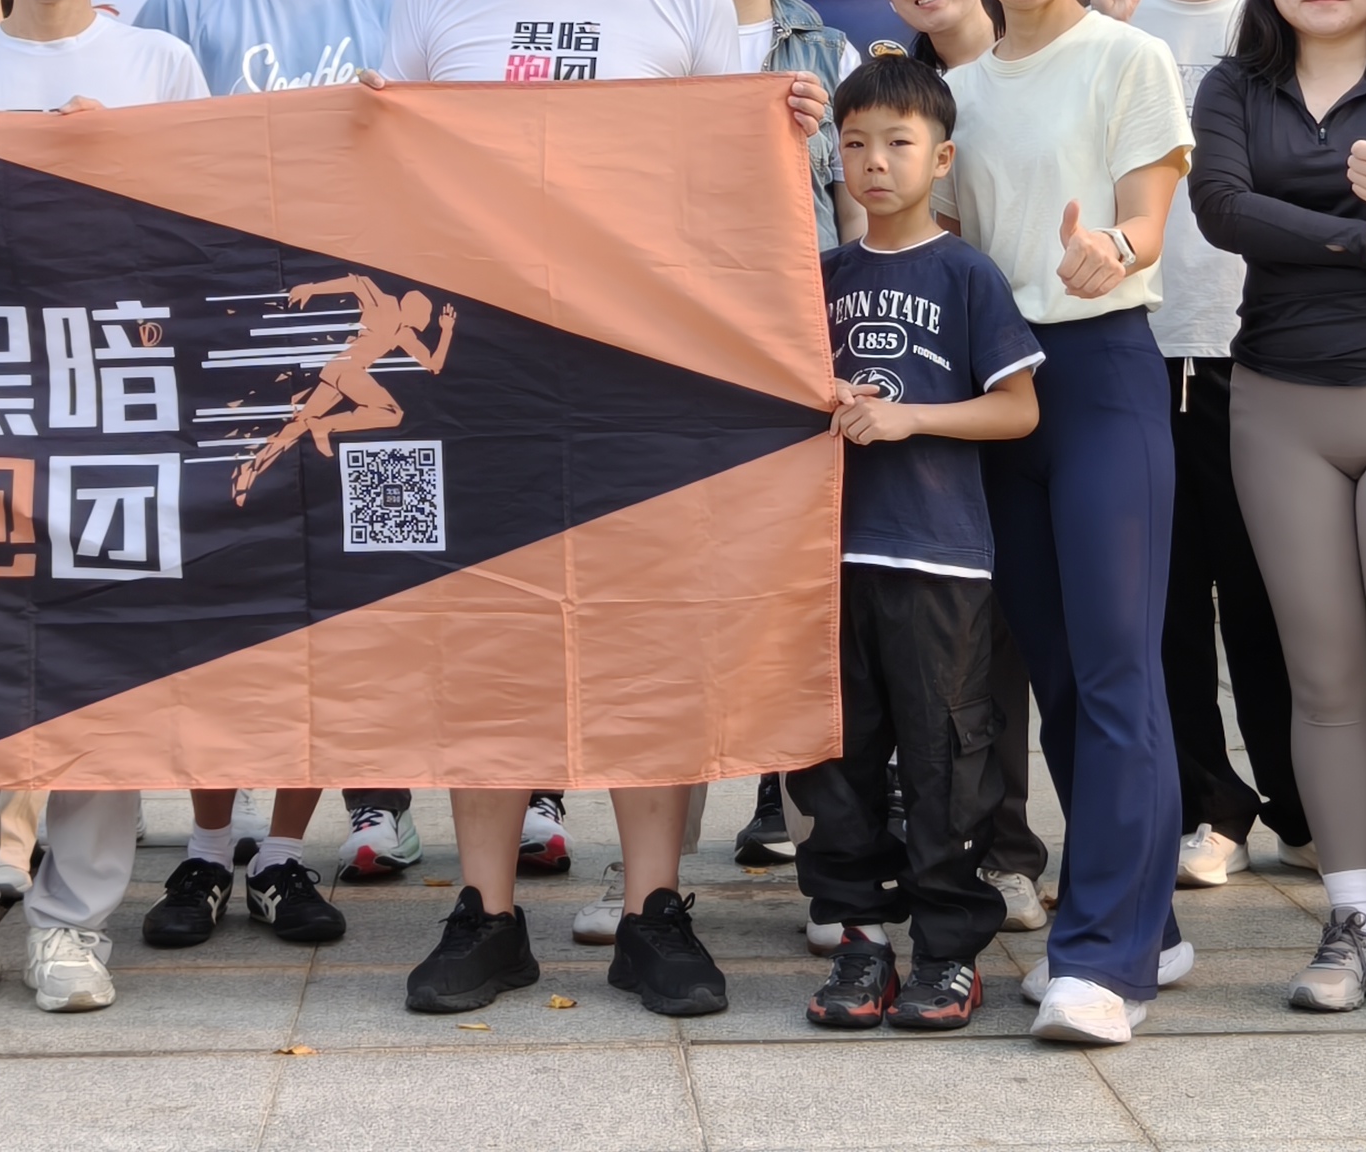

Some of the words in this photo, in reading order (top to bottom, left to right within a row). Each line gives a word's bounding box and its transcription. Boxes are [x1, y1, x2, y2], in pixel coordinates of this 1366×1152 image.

[511, 21, 601, 51] 黑暗
[504, 54, 597, 81] 跑团
[877, 289, 941, 335] STATE
[856, 332, 898, 349] 1855
